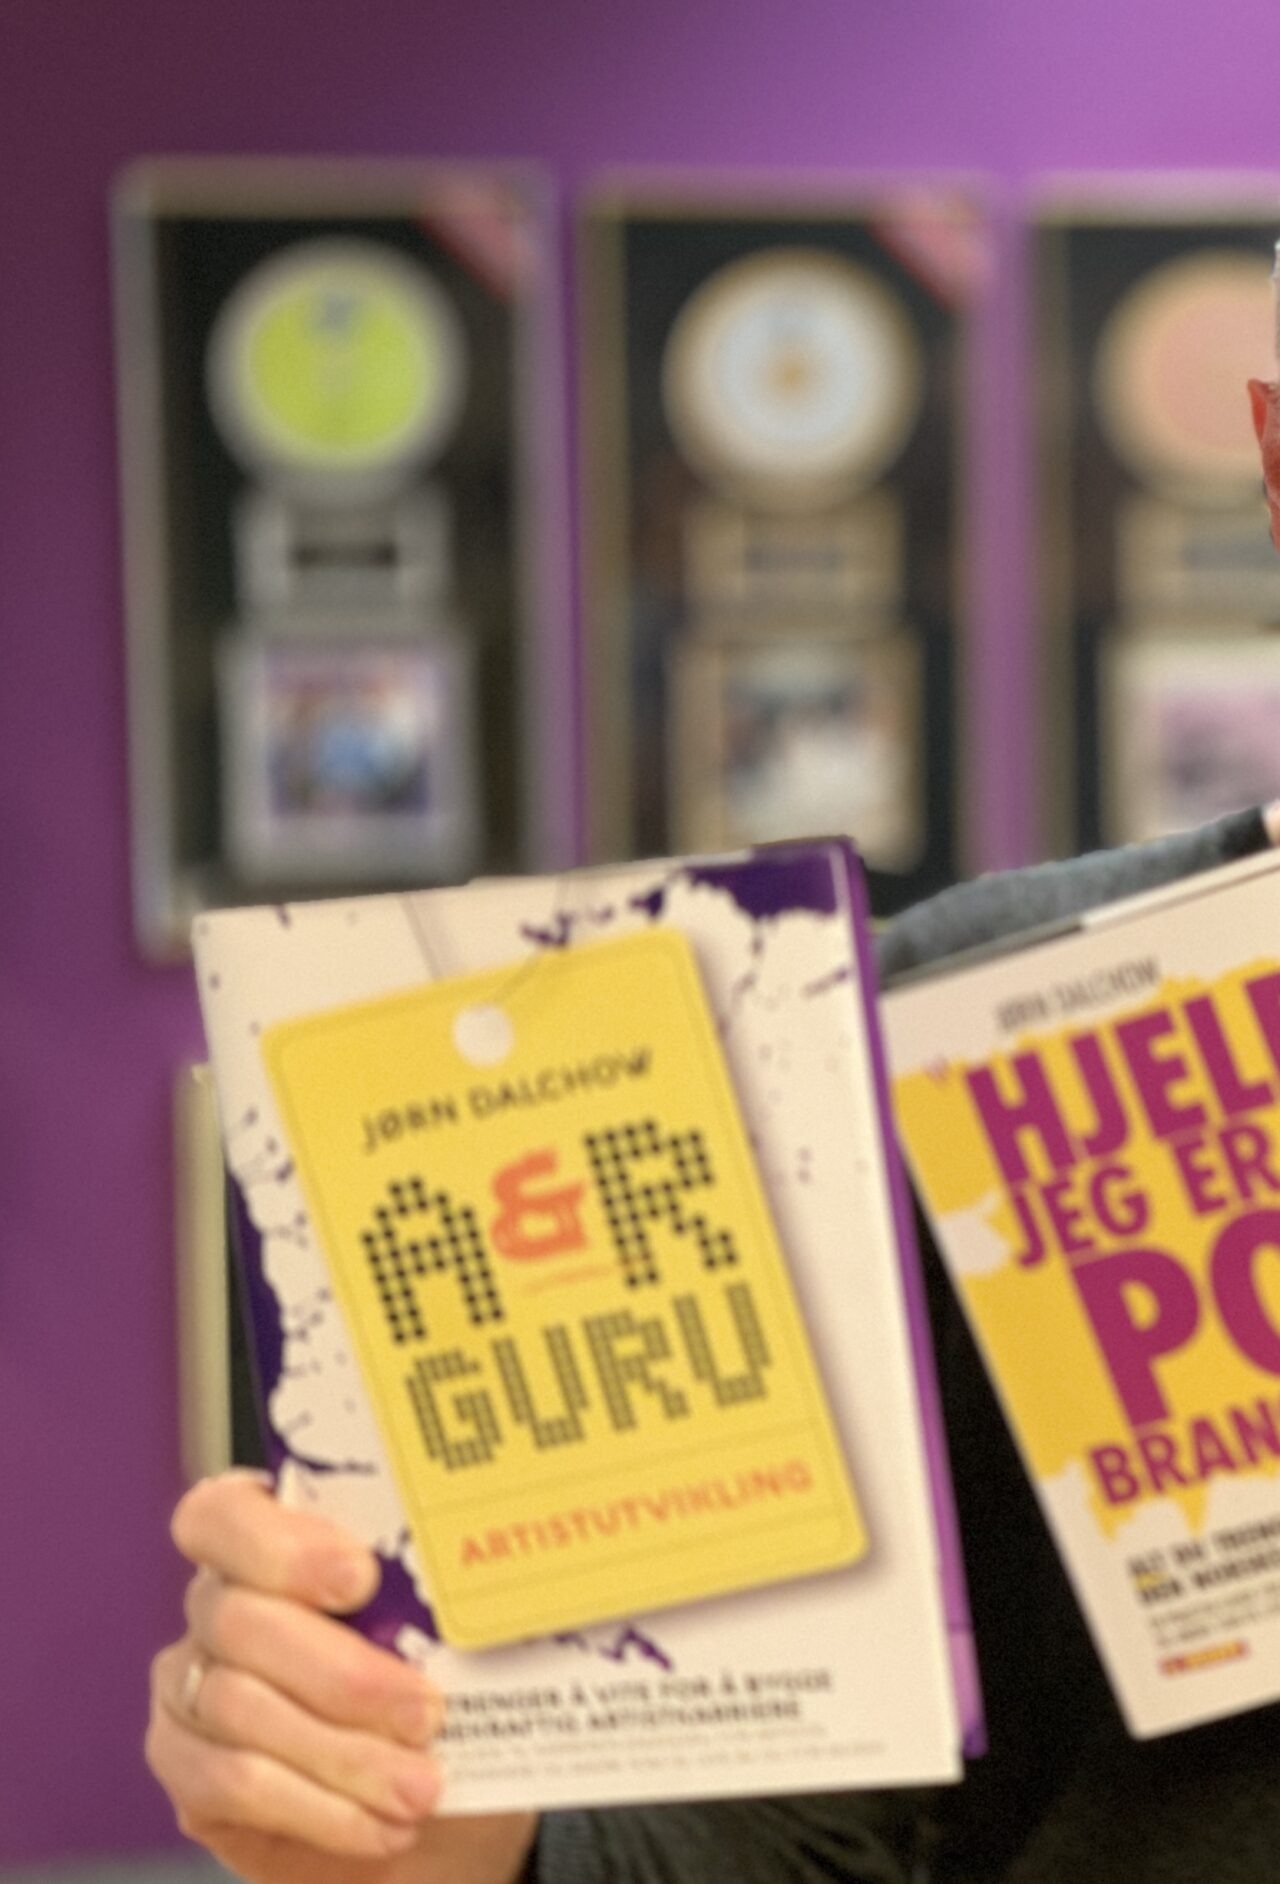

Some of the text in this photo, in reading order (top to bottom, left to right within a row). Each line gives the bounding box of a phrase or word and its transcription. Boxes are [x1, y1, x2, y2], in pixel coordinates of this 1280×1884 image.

[361, 1048, 653, 1155] JØRN DALCHOW
[1012, 1165, 1149, 1268] JEG
[406, 1281, 772, 1470] GURU
[460, 1459, 814, 1566] ARTISTUTVIKLING
